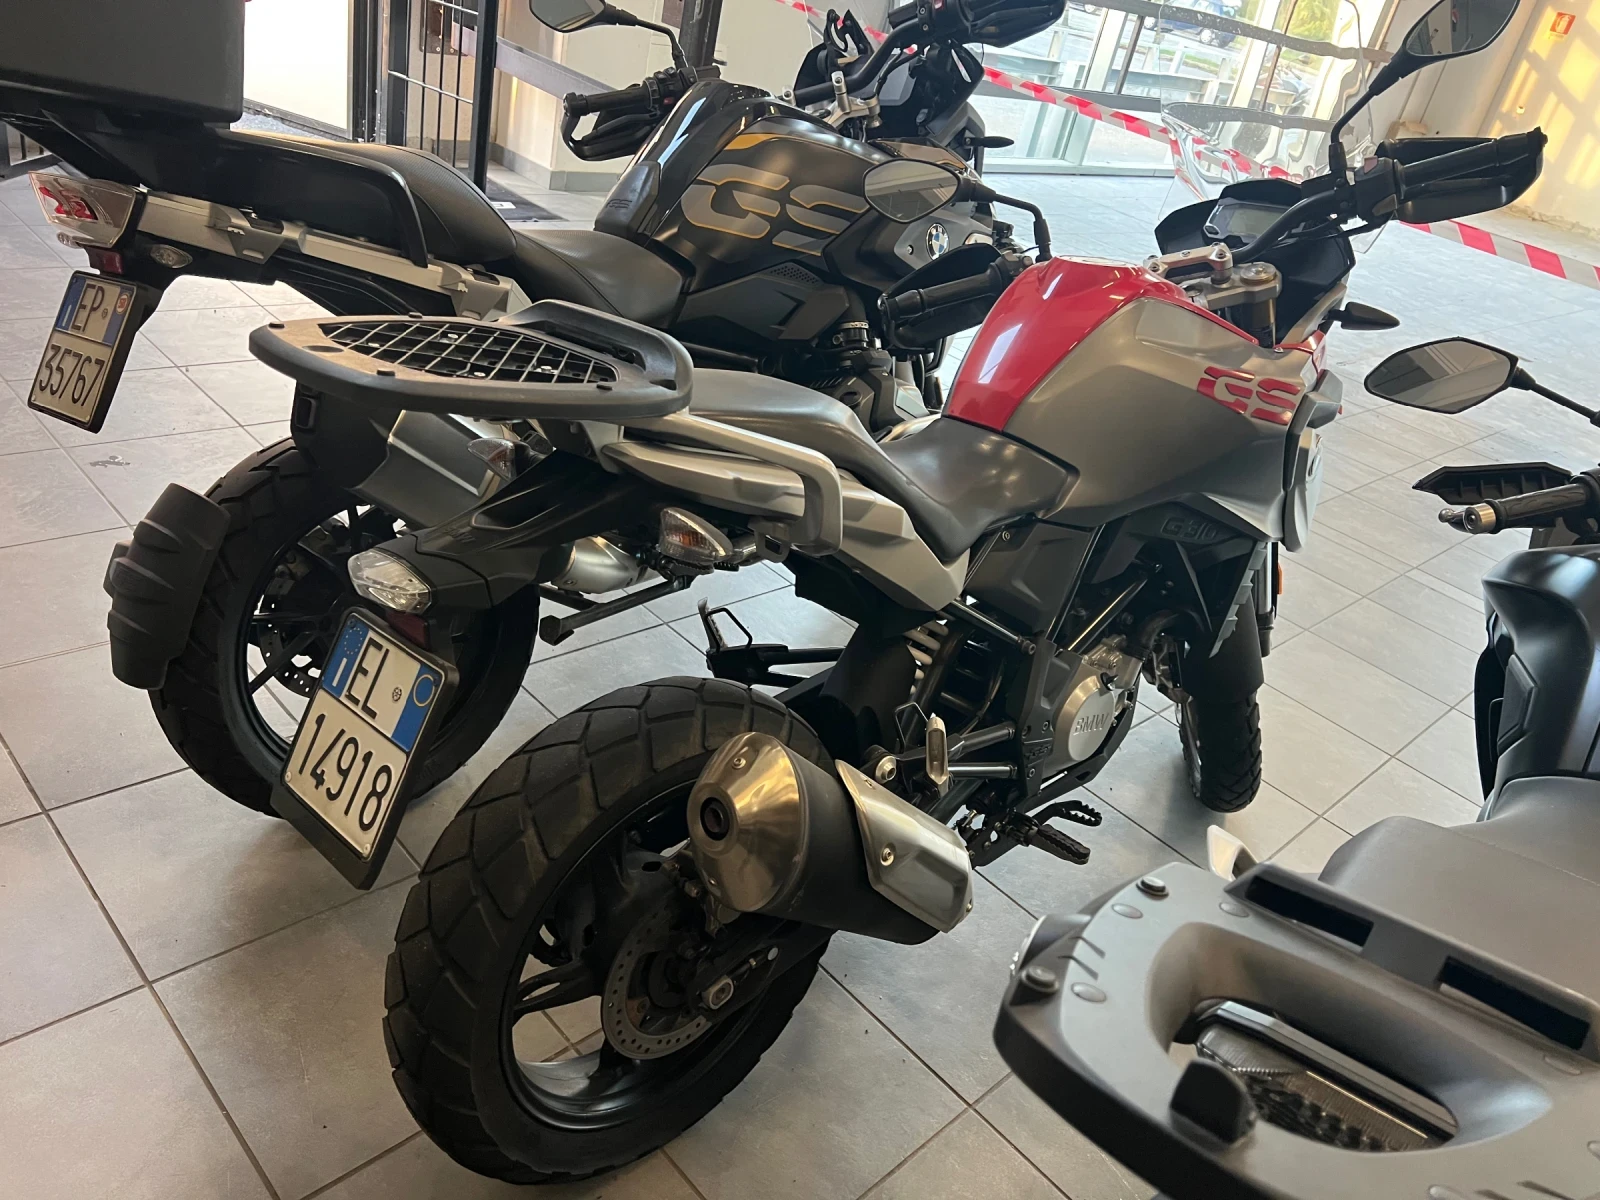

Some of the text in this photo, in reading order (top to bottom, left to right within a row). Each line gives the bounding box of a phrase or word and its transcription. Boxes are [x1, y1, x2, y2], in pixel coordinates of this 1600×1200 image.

[681, 163, 870, 256] GS
[71, 283, 105, 332] EP
[38, 344, 106, 406] 35767
[1197, 365, 1301, 426] GS
[345, 637, 389, 719] EL
[1073, 713, 1110, 736] BMW
[298, 713, 393, 832] 14918
